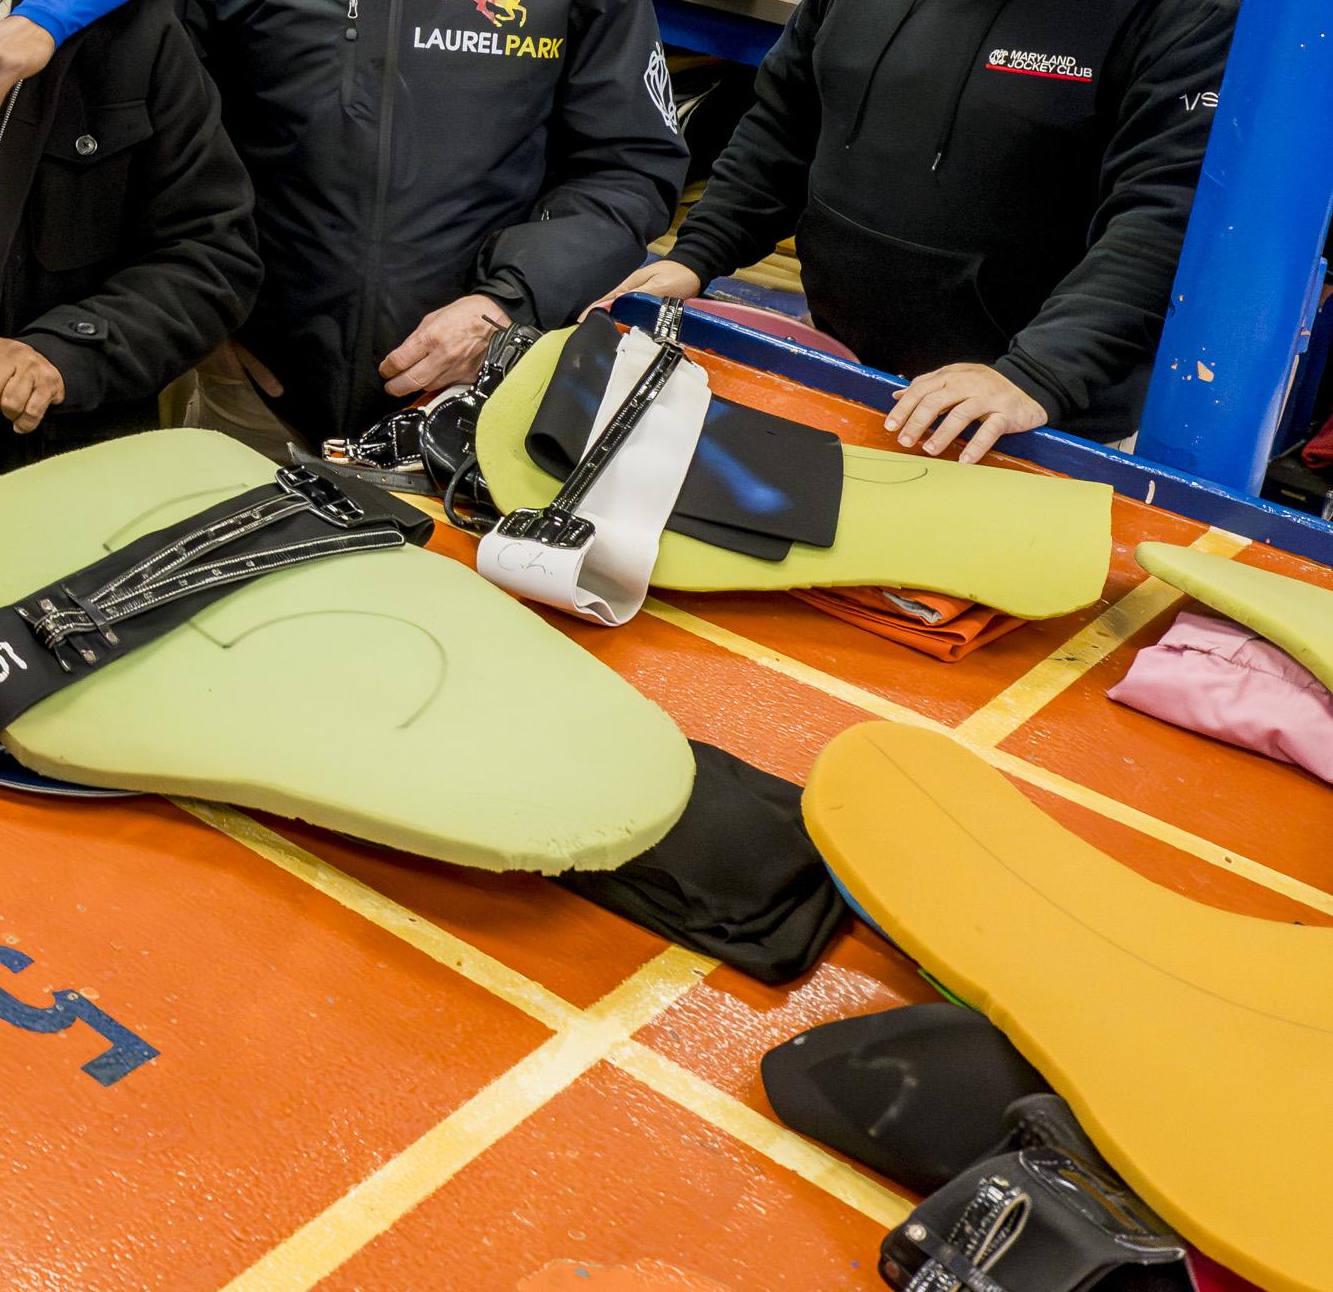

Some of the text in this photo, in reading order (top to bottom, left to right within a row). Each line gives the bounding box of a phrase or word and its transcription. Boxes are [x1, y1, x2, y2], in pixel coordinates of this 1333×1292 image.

[1010, 49, 1076, 67] MARYLAND
[1007, 59, 1093, 78] JOCKEY CLUB
